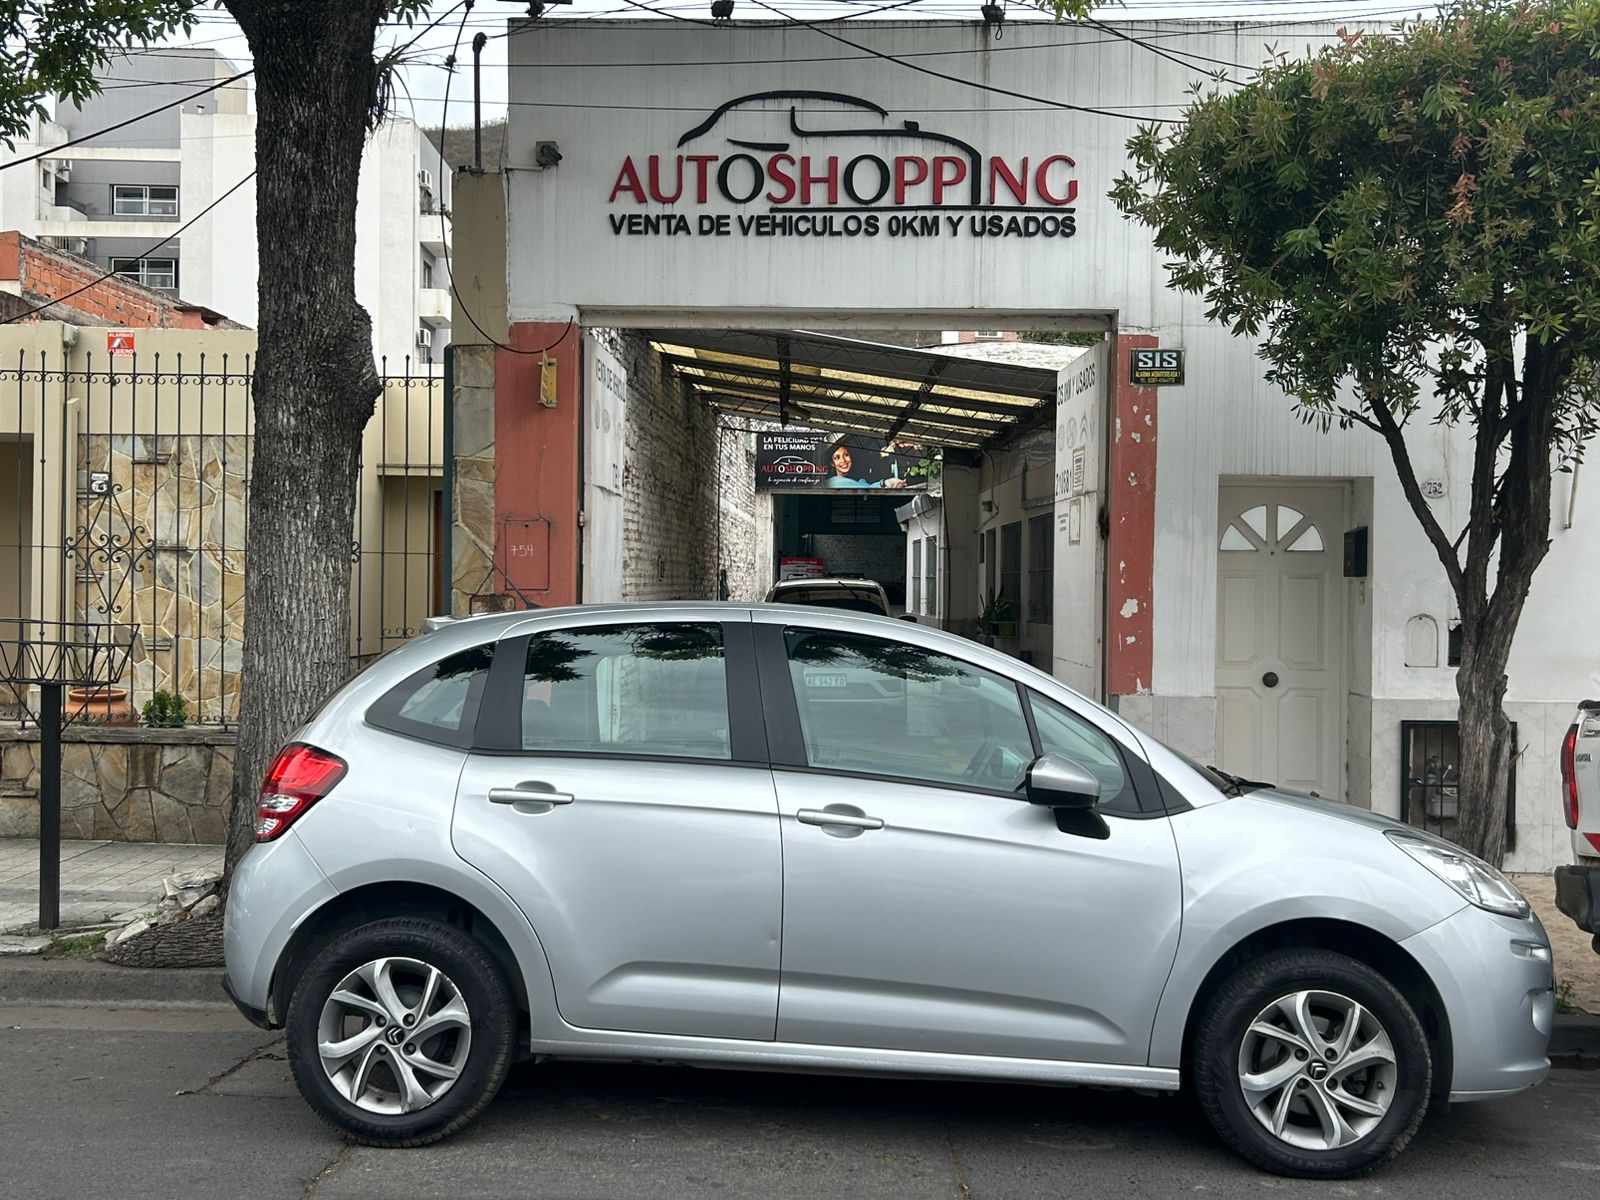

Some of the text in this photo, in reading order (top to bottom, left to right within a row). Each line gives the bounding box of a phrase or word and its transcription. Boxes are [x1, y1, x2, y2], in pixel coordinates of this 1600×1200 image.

[608, 152, 1079, 206] AUTOSHOPPING
[609, 213, 691, 236] VENTA
[698, 214, 731, 236] DE
[738, 213, 880, 237] VEHICULOS
[947, 214, 964, 237] Y
[970, 214, 1077, 238] USADOS
[1138, 352, 1177, 368] SIS
[762, 465, 829, 473] AUTOSHOPPING
[1427, 481, 1443, 495] 752
[511, 543, 534, 557] 754
